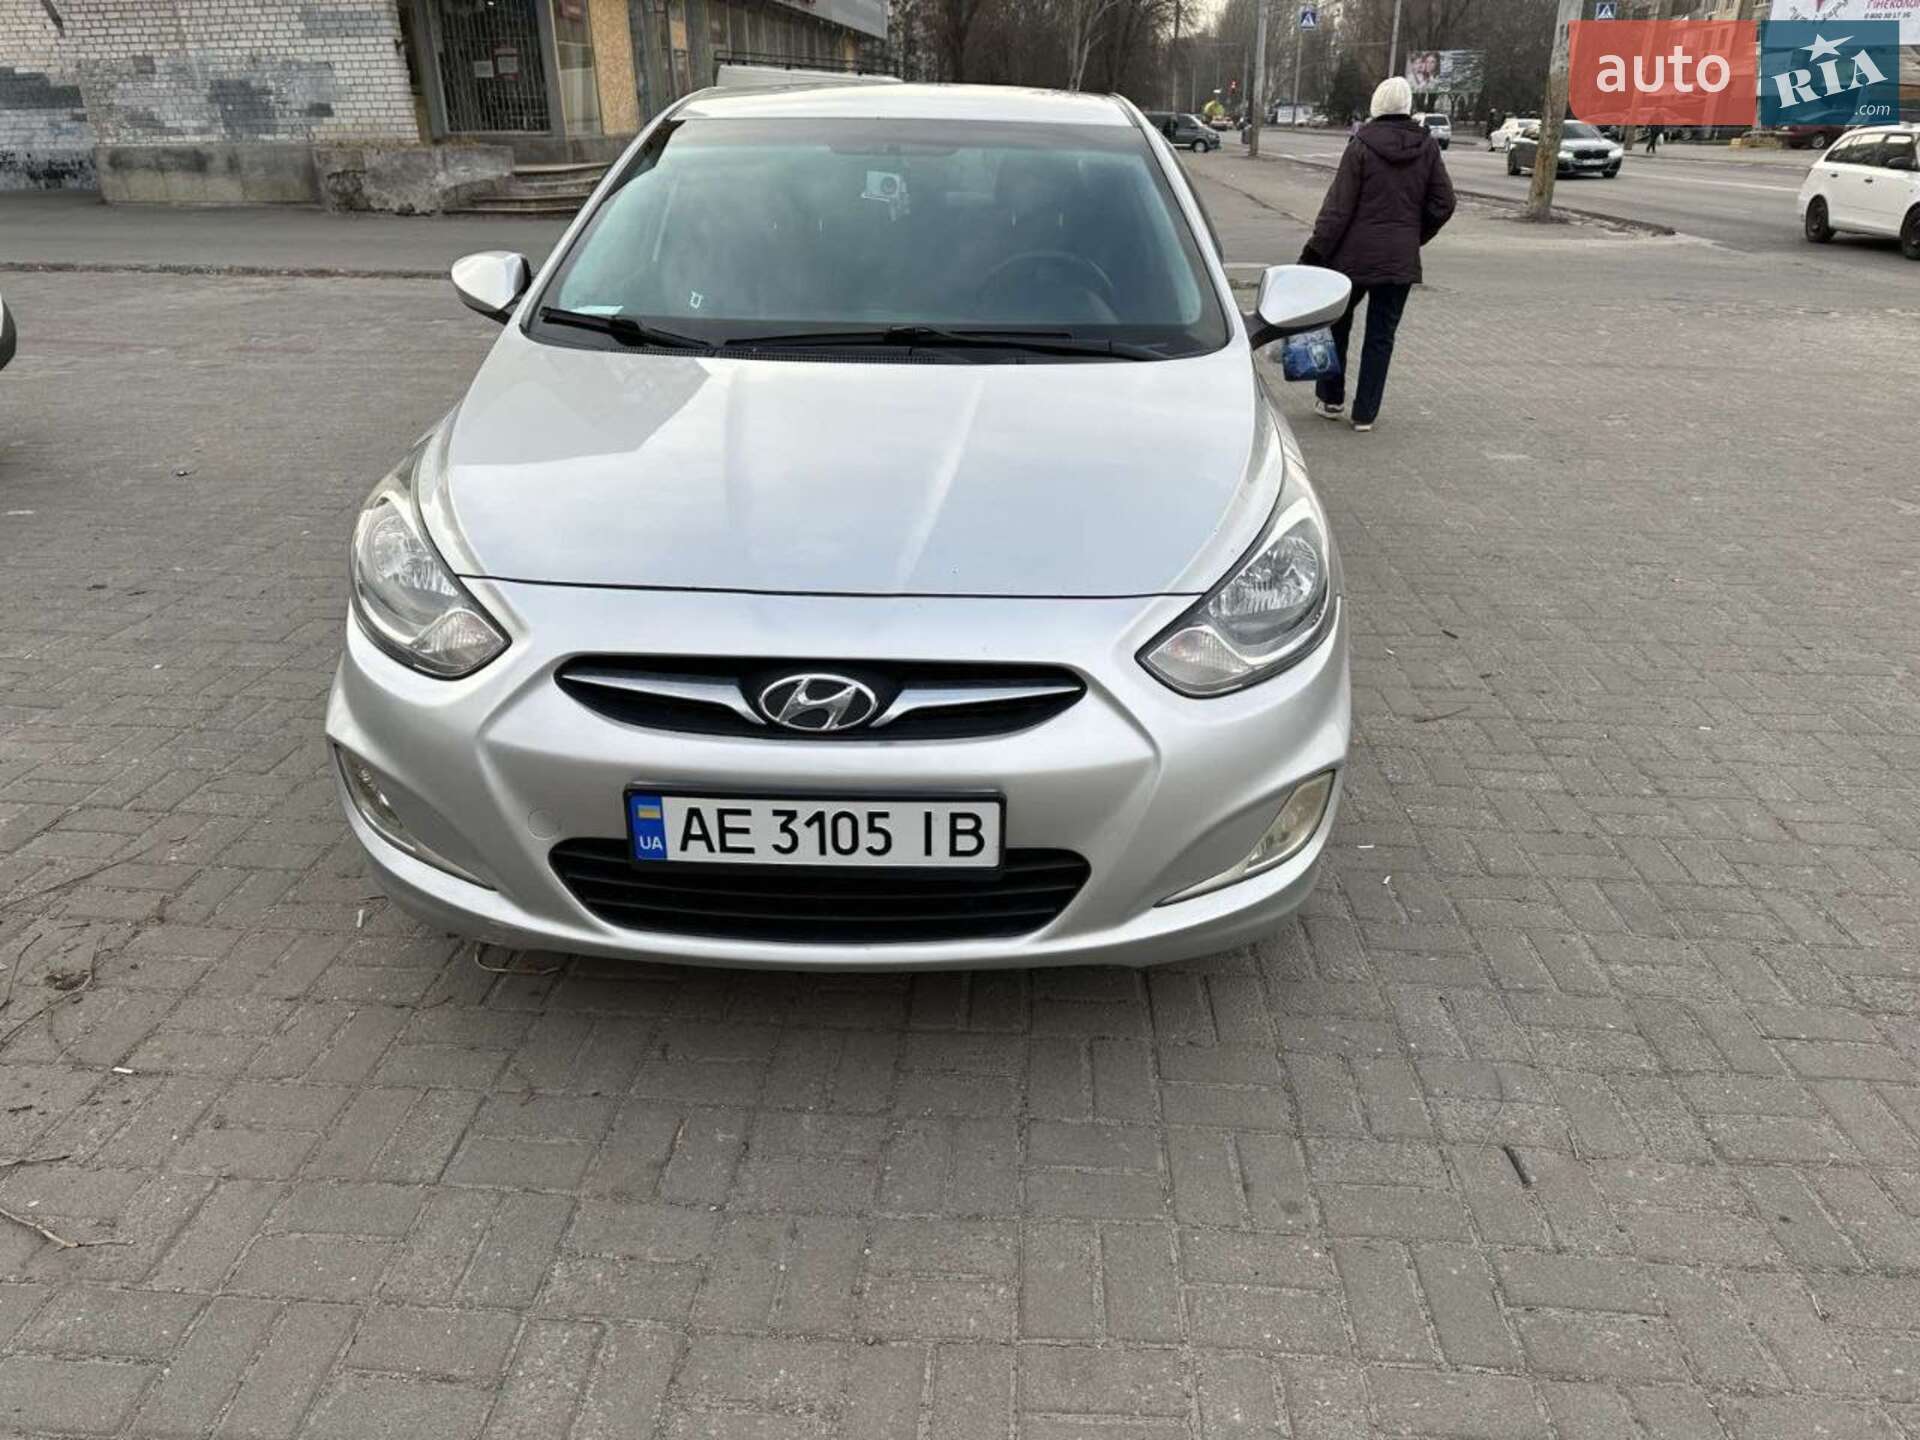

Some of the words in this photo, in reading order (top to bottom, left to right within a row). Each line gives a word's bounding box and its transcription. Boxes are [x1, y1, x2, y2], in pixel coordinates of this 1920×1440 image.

[639, 835, 664, 851] UA
[679, 807, 756, 855] AE
[771, 809, 893, 857] 3105
[923, 811, 986, 858] IB
